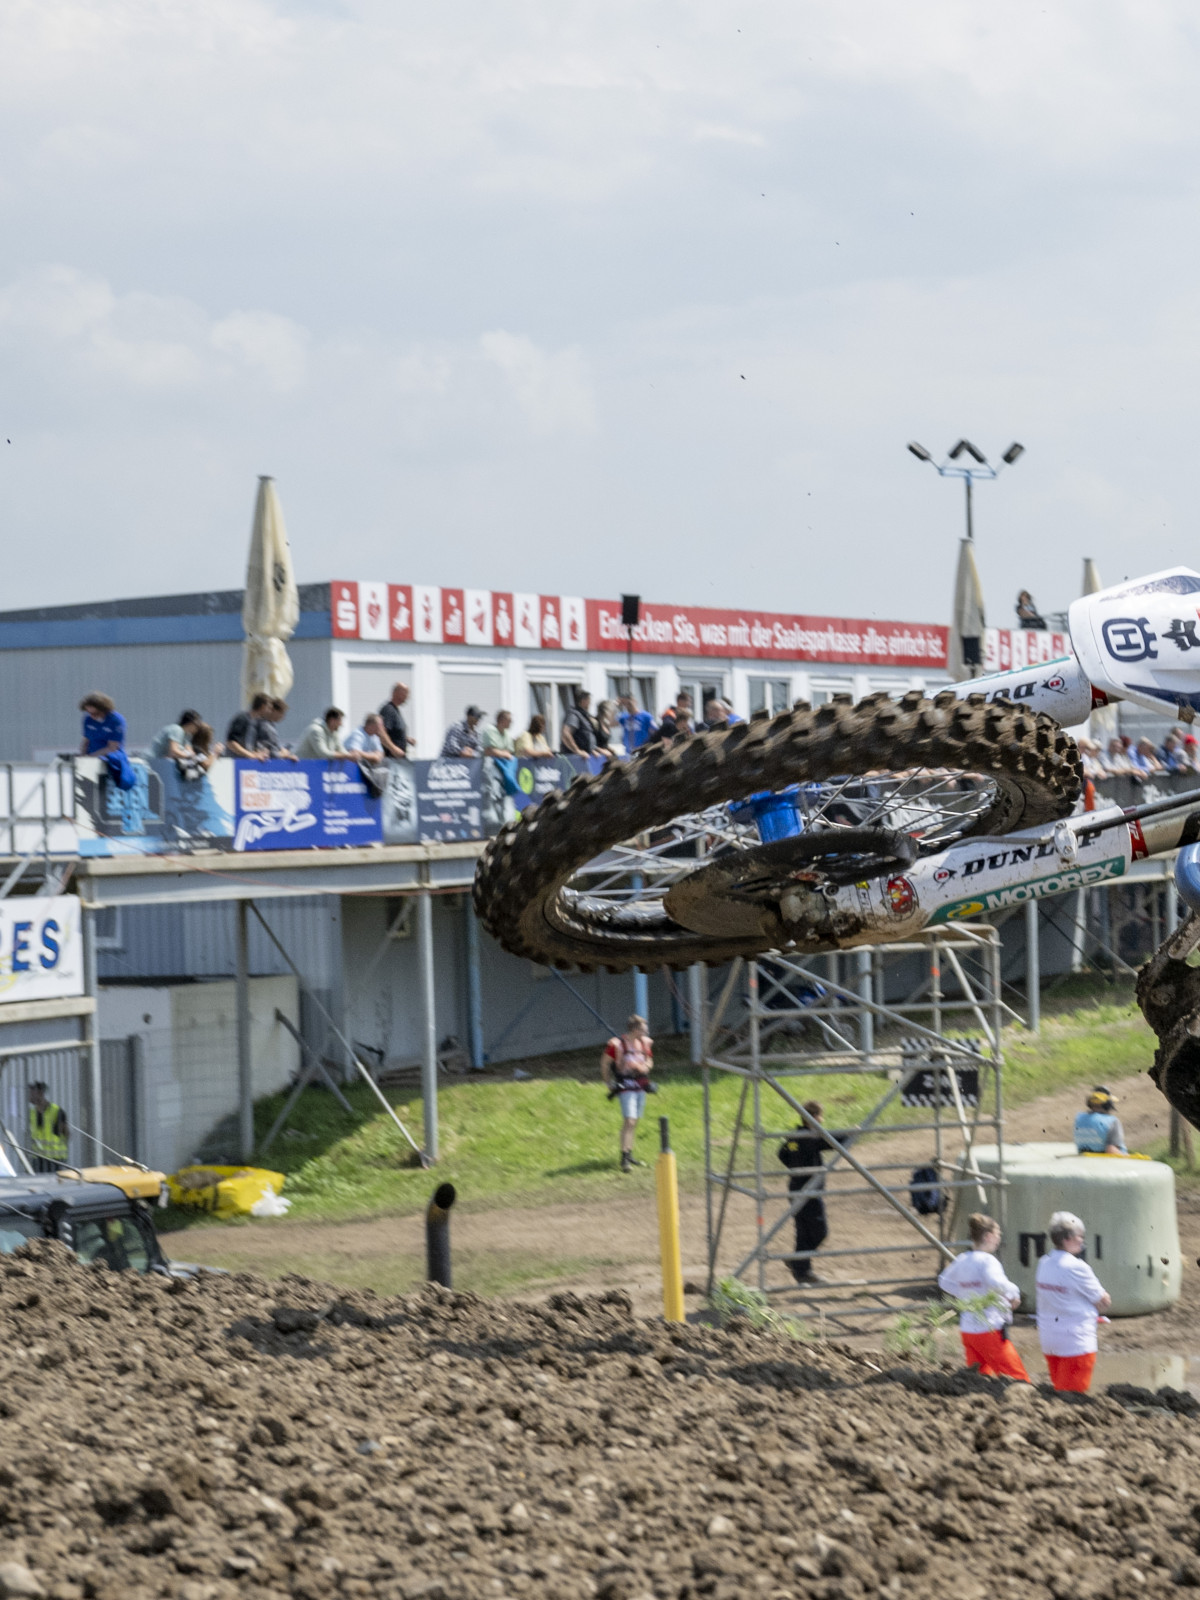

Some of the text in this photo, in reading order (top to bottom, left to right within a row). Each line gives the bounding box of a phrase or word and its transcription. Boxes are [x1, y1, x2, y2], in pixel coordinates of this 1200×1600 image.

[700, 623, 727, 646] was
[728, 617, 751, 647] mit
[751, 619, 773, 648] der
[862, 627, 888, 655] alles
[962, 828, 1102, 878] DUNLP
[986, 862, 1118, 910] MOTOREX
